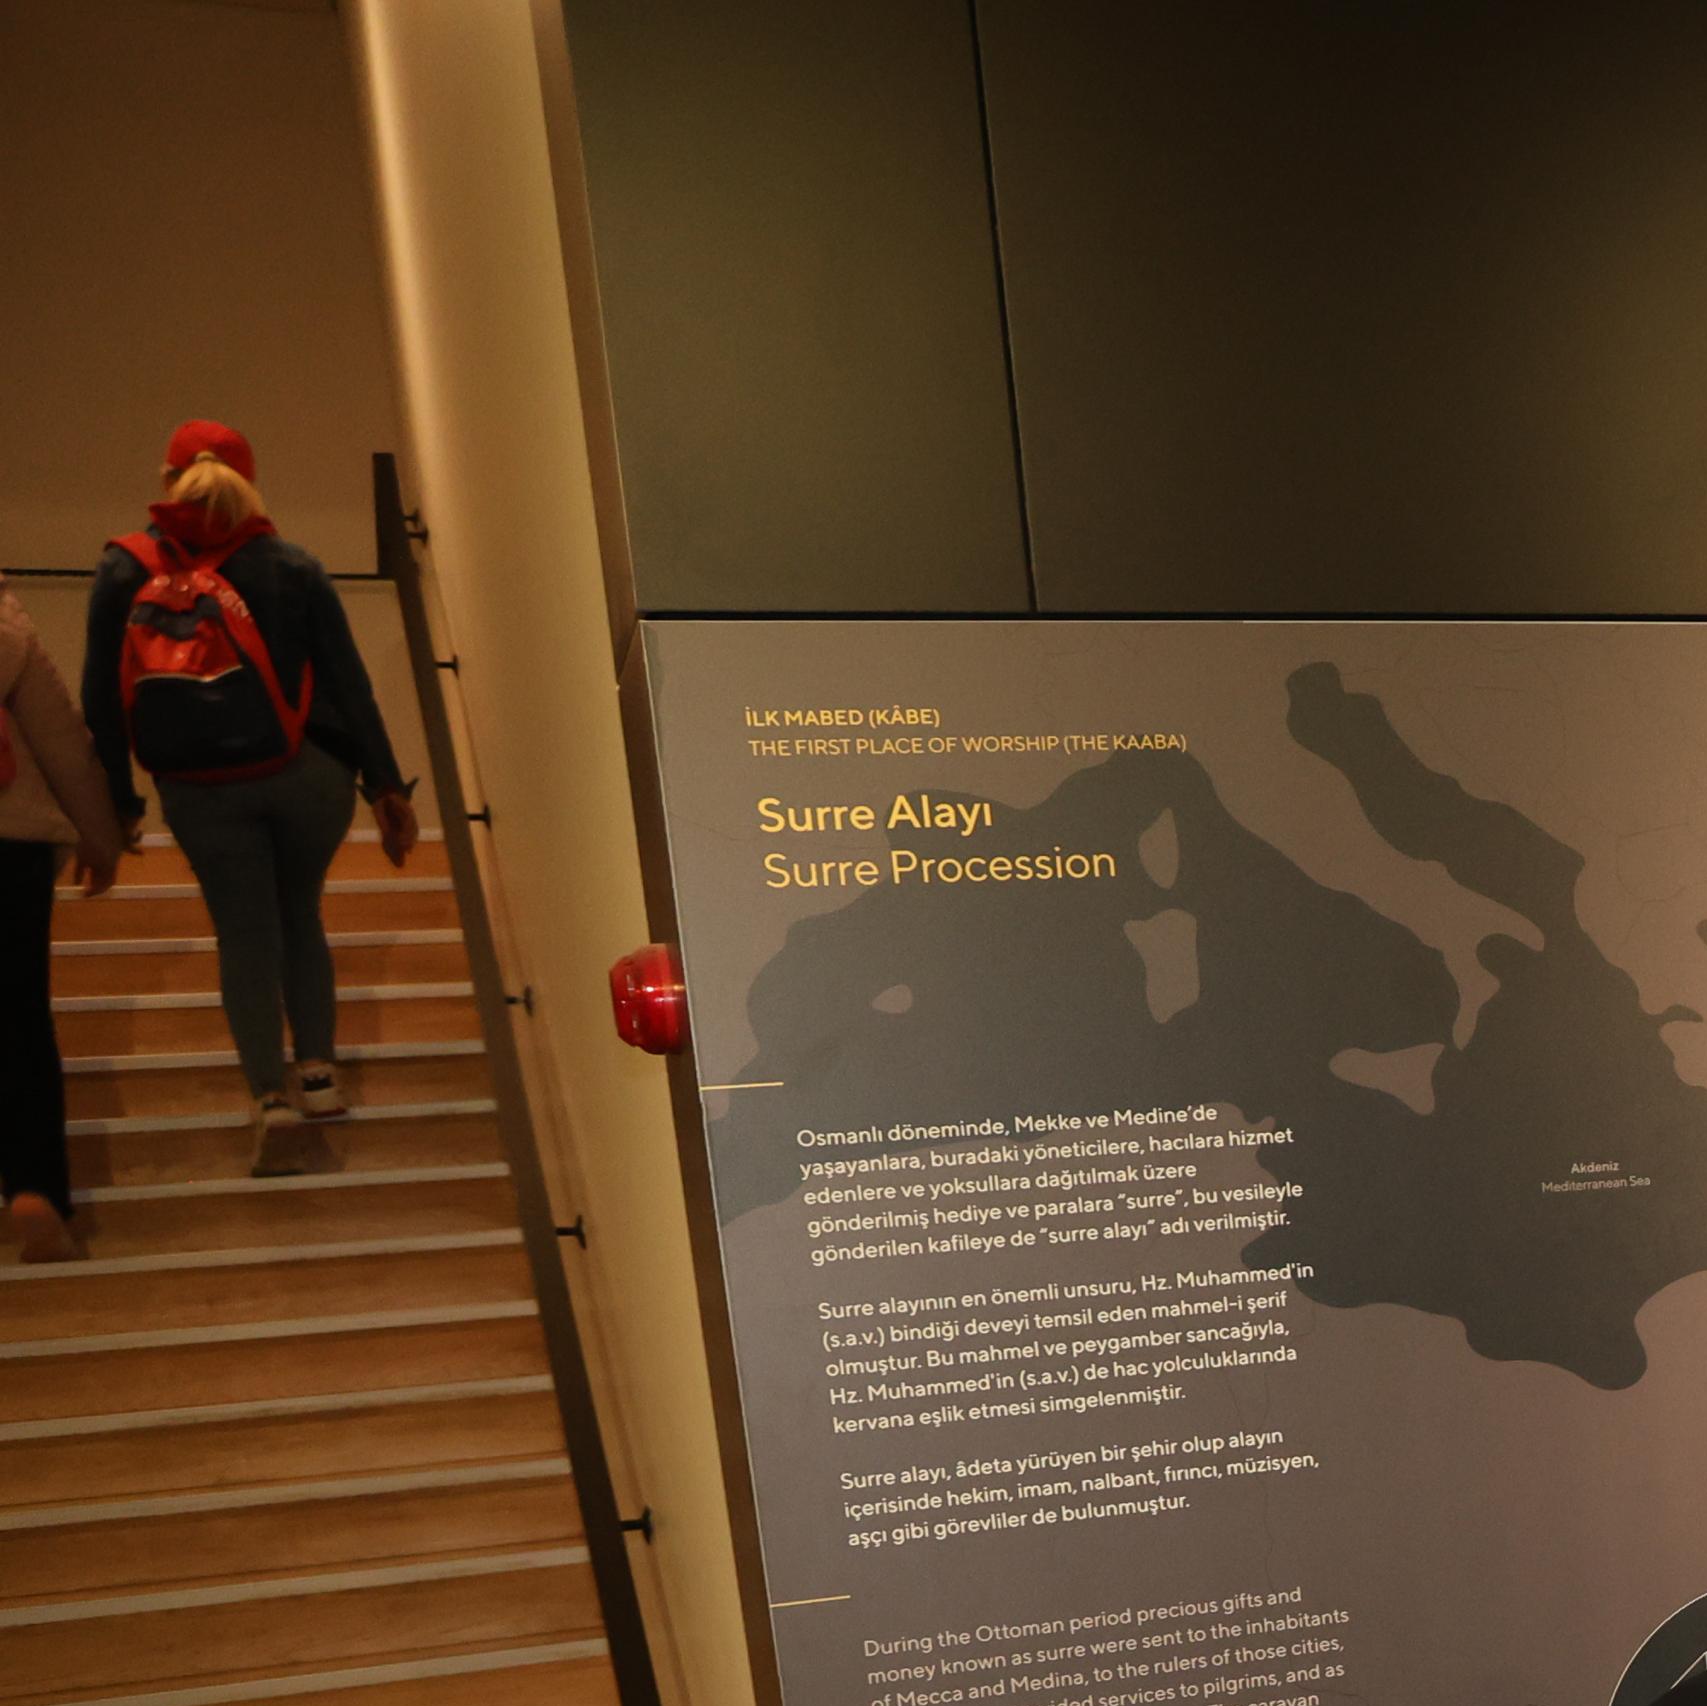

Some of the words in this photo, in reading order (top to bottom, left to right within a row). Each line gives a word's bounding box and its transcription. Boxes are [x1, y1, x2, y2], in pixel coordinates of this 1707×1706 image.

[745, 706, 780, 727] İLK
[783, 709, 864, 726] MABED
[868, 704, 940, 729] (KÂBE)
[747, 739, 792, 757] THE
[794, 738, 851, 756] FIRST
[855, 737, 925, 755] PLACE
[927, 737, 958, 754] OF
[961, 735, 1060, 753] WORSHIP
[1063, 734, 1109, 755] (THE
[1113, 733, 1187, 753] KAABA)
[757, 797, 875, 833] Surre
[887, 794, 993, 837] Alayı
[764, 853, 880, 889] Surre
[890, 846, 1116, 885] Procession
[796, 1125, 883, 1148] Osmanlı
[887, 1118, 1010, 1142] döneminde,
[1014, 1113, 1082, 1133] Mekke
[1085, 1114, 1110, 1129] ve
[799, 1154, 926, 1181] yaşayanlara,
[930, 1144, 1019, 1167] buradaki
[1022, 1138, 1145, 1166] yöneticilere,
[1148, 1132, 1225, 1152] hacılara
[1228, 1127, 1295, 1147] hizmet
[1571, 1161, 1619, 1174] Akdeniz
[803, 1184, 897, 1205] edenlere
[900, 1184, 925, 1198] ve
[928, 1174, 1031, 1201] yoksullara
[1035, 1165, 1139, 1191] dağıtılmak
[1142, 1164, 1197, 1181] üzere
[1541, 1178, 1627, 1193] Mediterranean
[1629, 1176, 1651, 1187] Sea
[807, 1209, 930, 1238] gönderilmiş
[933, 1204, 1002, 1225] hediye
[1005, 1204, 1030, 1218] ve
[1034, 1196, 1114, 1221] paralara
[1192, 1187, 1218, 1205] bu
[1221, 1181, 1304, 1203] vesileyle
[811, 1239, 924, 1267] gönderilen
[927, 1233, 1006, 1254] kafileye
[1010, 1229, 1036, 1247] de
[1160, 1216, 1190, 1235] adı
[1193, 1209, 1291, 1232] verilmiştir.
[818, 1302, 874, 1320] Surre
[879, 1296, 957, 1317] alayının
[961, 1293, 987, 1308] en
[990, 1283, 1059, 1305] önemli
[1063, 1281, 1137, 1299] unsuru,
[1141, 1274, 1173, 1292] Hz.
[840, 1472, 896, 1490] Surre
[900, 1465, 952, 1485] alayı,
[955, 1458, 1013, 1478] âdeta
[1016, 1451, 1097, 1476] yürüyen
[1100, 1444, 1127, 1462] bir
[1130, 1439, 1178, 1463] şehir
[1181, 1435, 1225, 1454] olup
[1228, 1431, 1284, 1450] alayın
[843, 1492, 943, 1522] içerisinde
[946, 1486, 1014, 1507] hekim,
[1017, 1481, 1078, 1499] imam,
[1081, 1469, 1161, 1492] nalbant,
[1163, 1465, 1223, 1483] fırıncı,
[1226, 1454, 1320, 1476] müzisyen,
[848, 1530, 888, 1549] aşçı
[891, 1521, 930, 1546] gibi
[933, 1512, 1028, 1541] görevliler
[1031, 1507, 1058, 1525] de
[1061, 1495, 1191, 1522] bulunmuştur.
